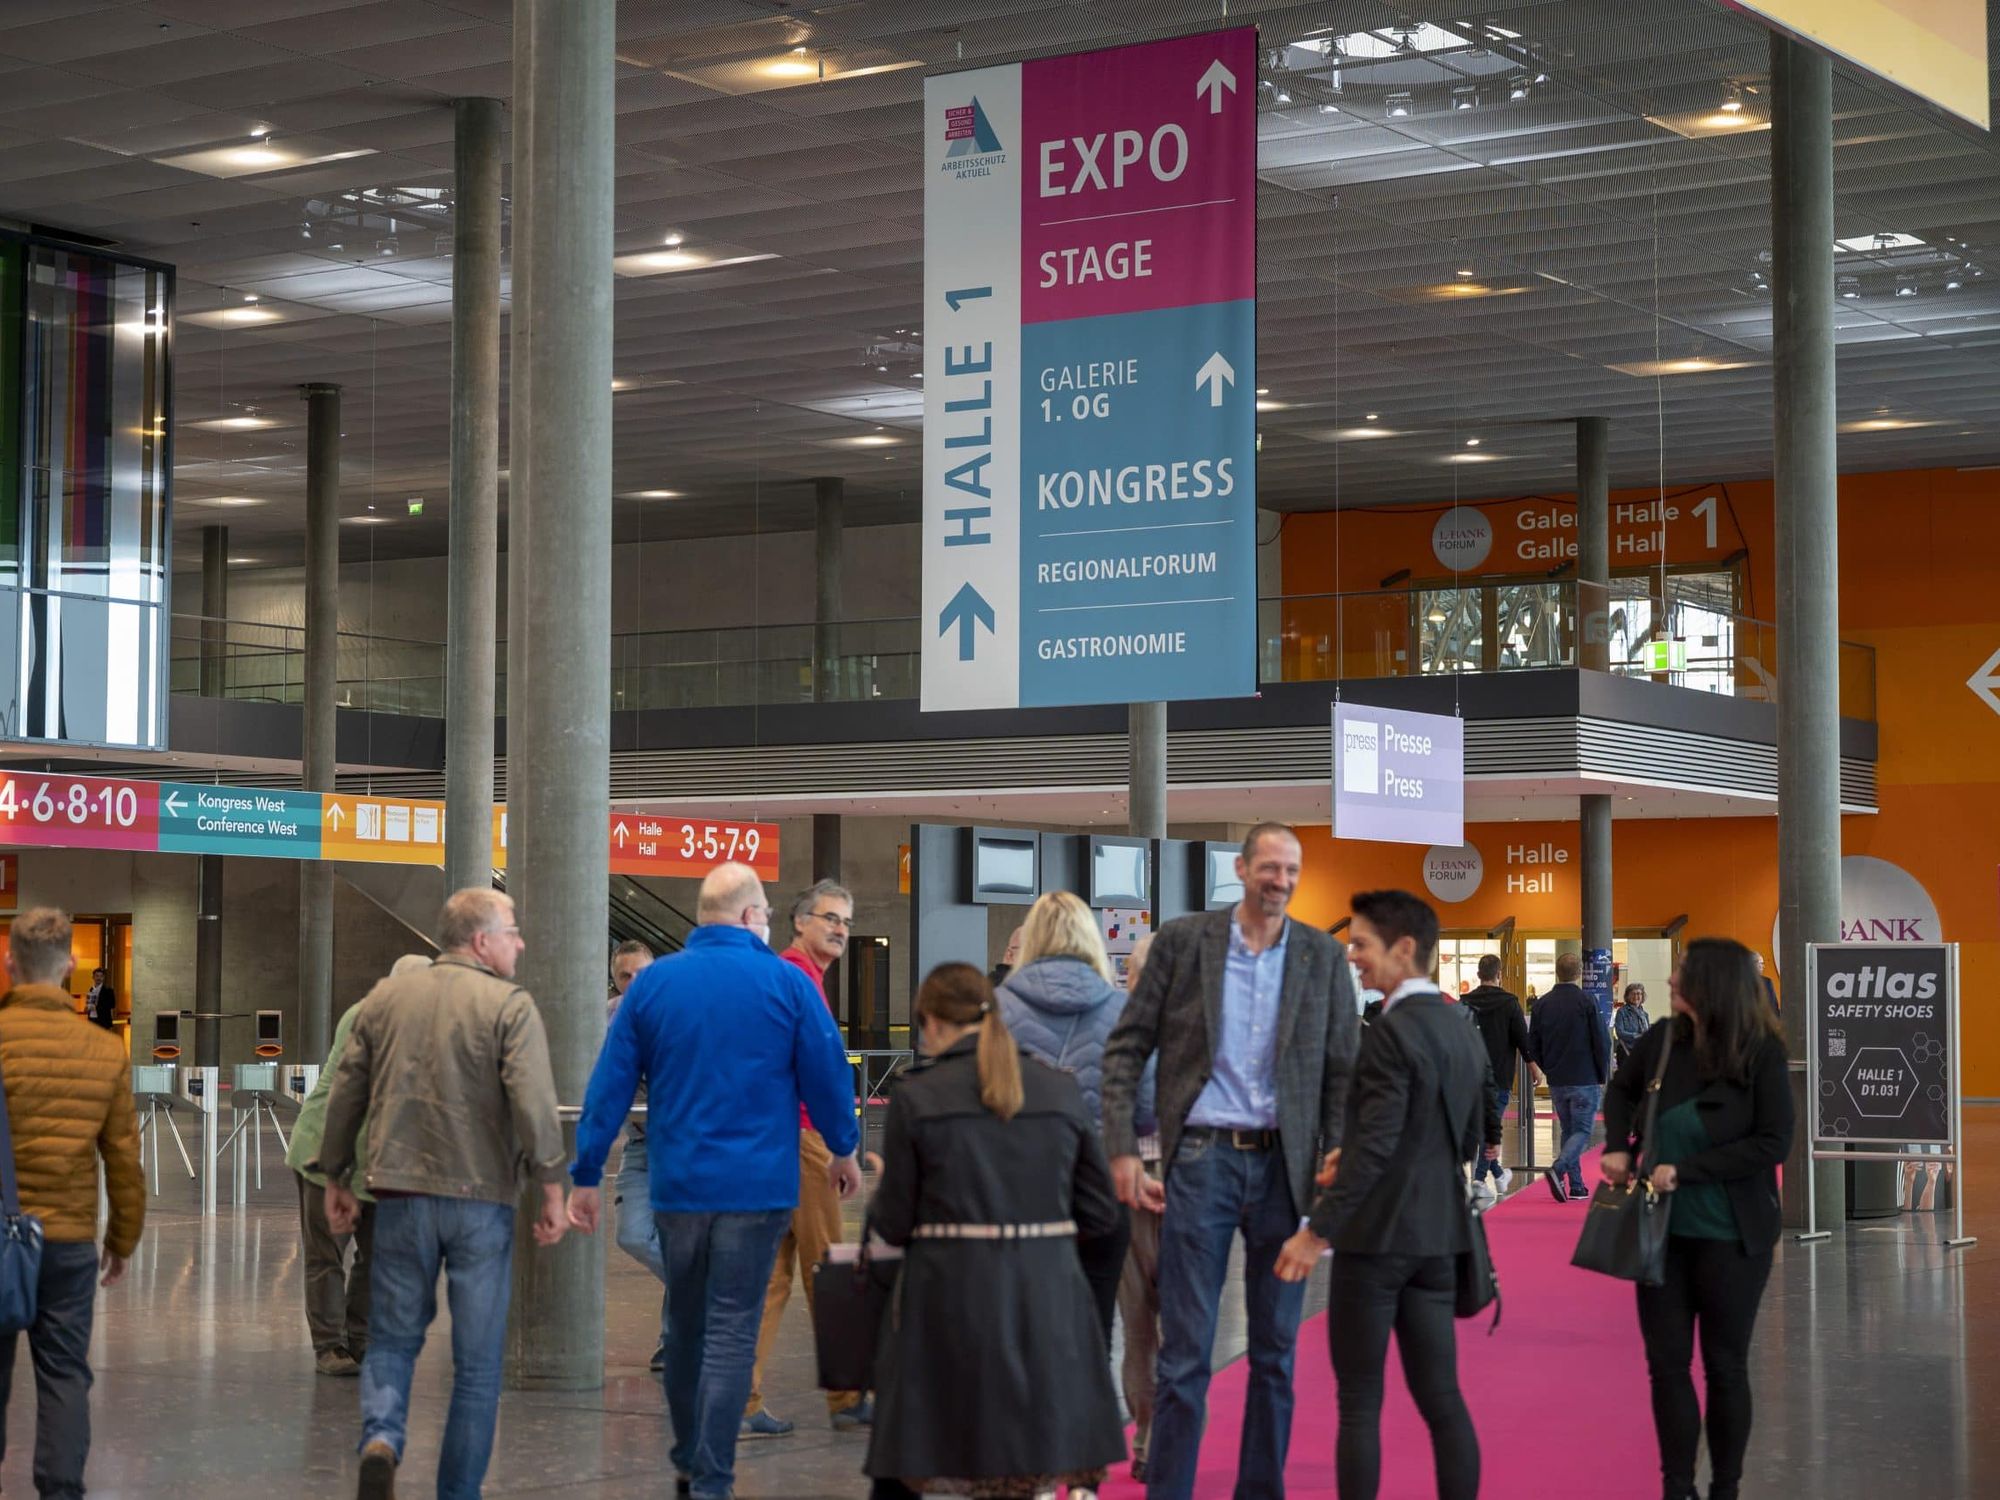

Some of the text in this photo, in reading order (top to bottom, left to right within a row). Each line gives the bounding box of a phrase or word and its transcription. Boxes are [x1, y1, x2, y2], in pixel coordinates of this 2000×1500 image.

[941, 154, 1006, 172] ARBEITSSCHUTZ
[1040, 123, 1188, 198] EXPO
[956, 166, 991, 180] AKTUELL
[1040, 239, 1152, 288] STAGE
[1040, 359, 1138, 392] GALERIE
[944, 286, 992, 547] HALLE 1
[1041, 393, 1109, 423] 1. OG
[1038, 457, 1235, 511] KONGRESS
[1616, 501, 1680, 524] Halle
[1691, 497, 1717, 549] 1
[1439, 539, 1476, 550] FORUM
[1516, 531, 1664, 560] Galle Hall
[1038, 551, 1217, 583] REGIONALFORUM
[1038, 632, 1186, 660] GASTRONOMIE
[1344, 732, 1377, 753] press
[1384, 723, 1432, 756] Presse
[1384, 768, 1424, 799] Press
[198, 792, 286, 813] Kongress West
[197, 816, 298, 836] Conference West
[639, 822, 663, 836] Halle
[639, 842, 657, 856] Hall
[1507, 843, 1568, 864] Halle
[1429, 871, 1467, 880] FORUM
[1507, 872, 1553, 893] Hall
[1827, 966, 1937, 999] atlas
[1827, 1004, 1934, 1018] SAFETY SHOES
[1857, 1068, 1903, 1081] HALLE 1
[1860, 1084, 1900, 1097] D1.031
